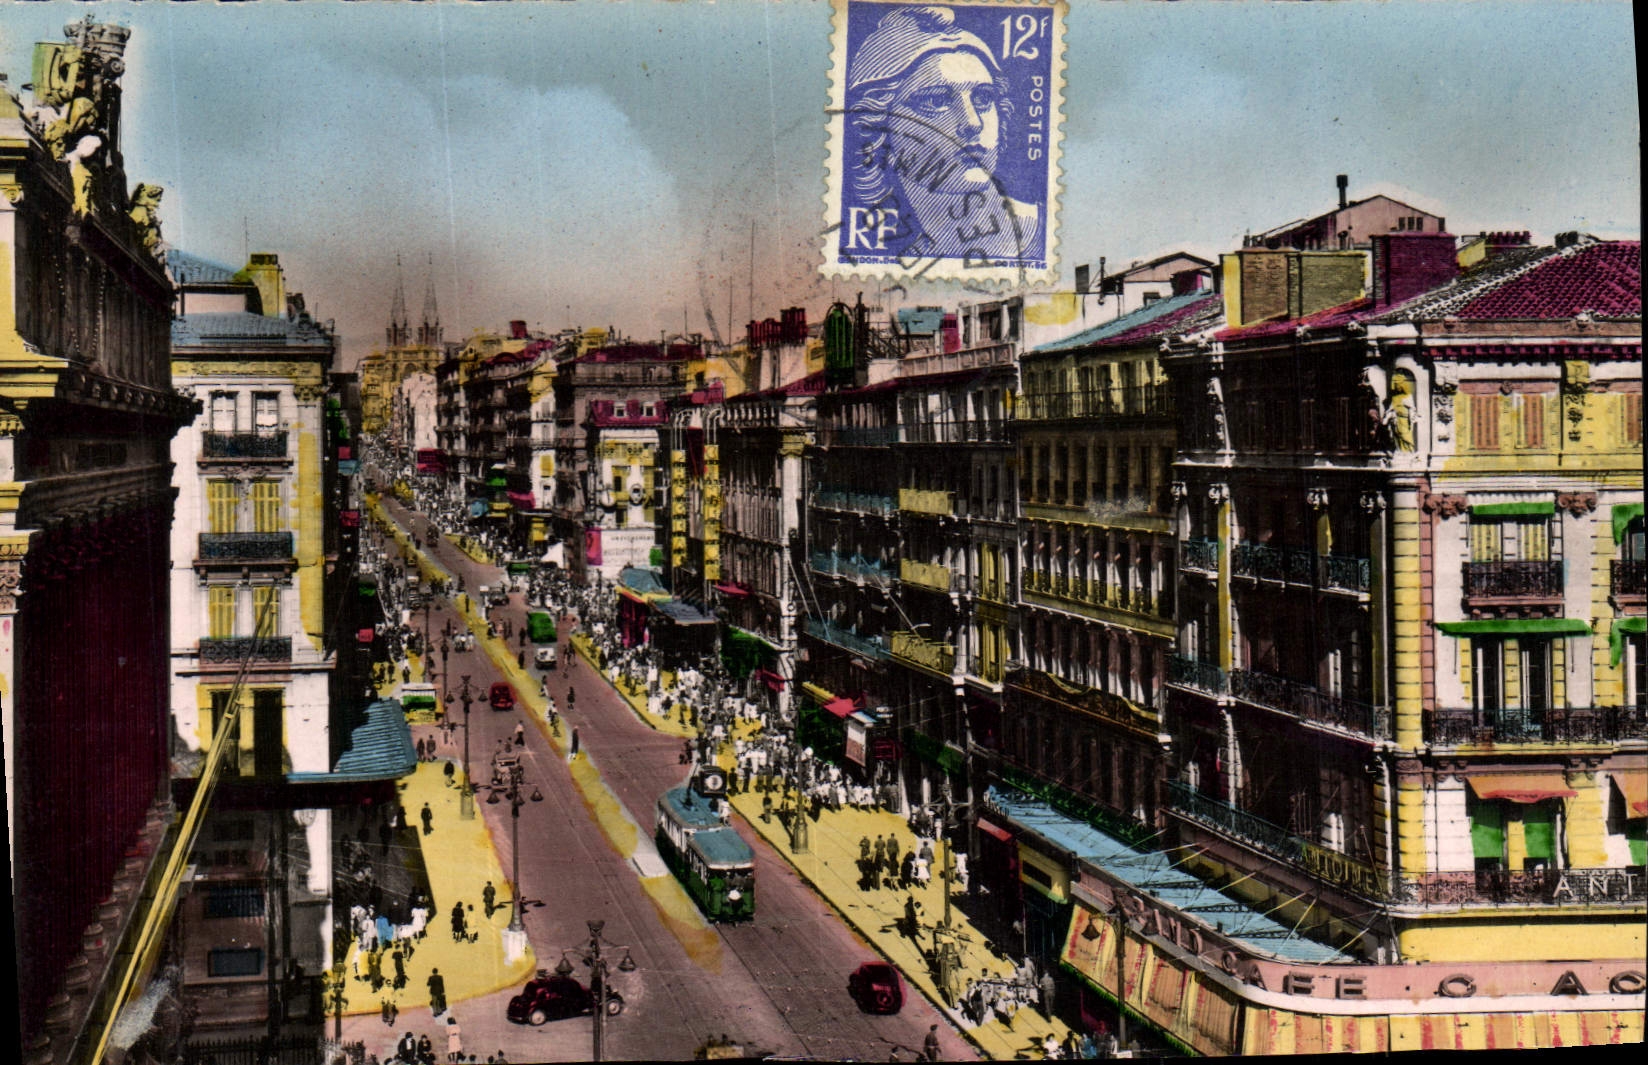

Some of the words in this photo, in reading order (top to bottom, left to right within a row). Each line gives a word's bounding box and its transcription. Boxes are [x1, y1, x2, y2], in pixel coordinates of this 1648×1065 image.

[1027, 75, 1044, 161] POSTES
[844, 206, 899, 250] RF
[1552, 873, 1639, 897] ANT
